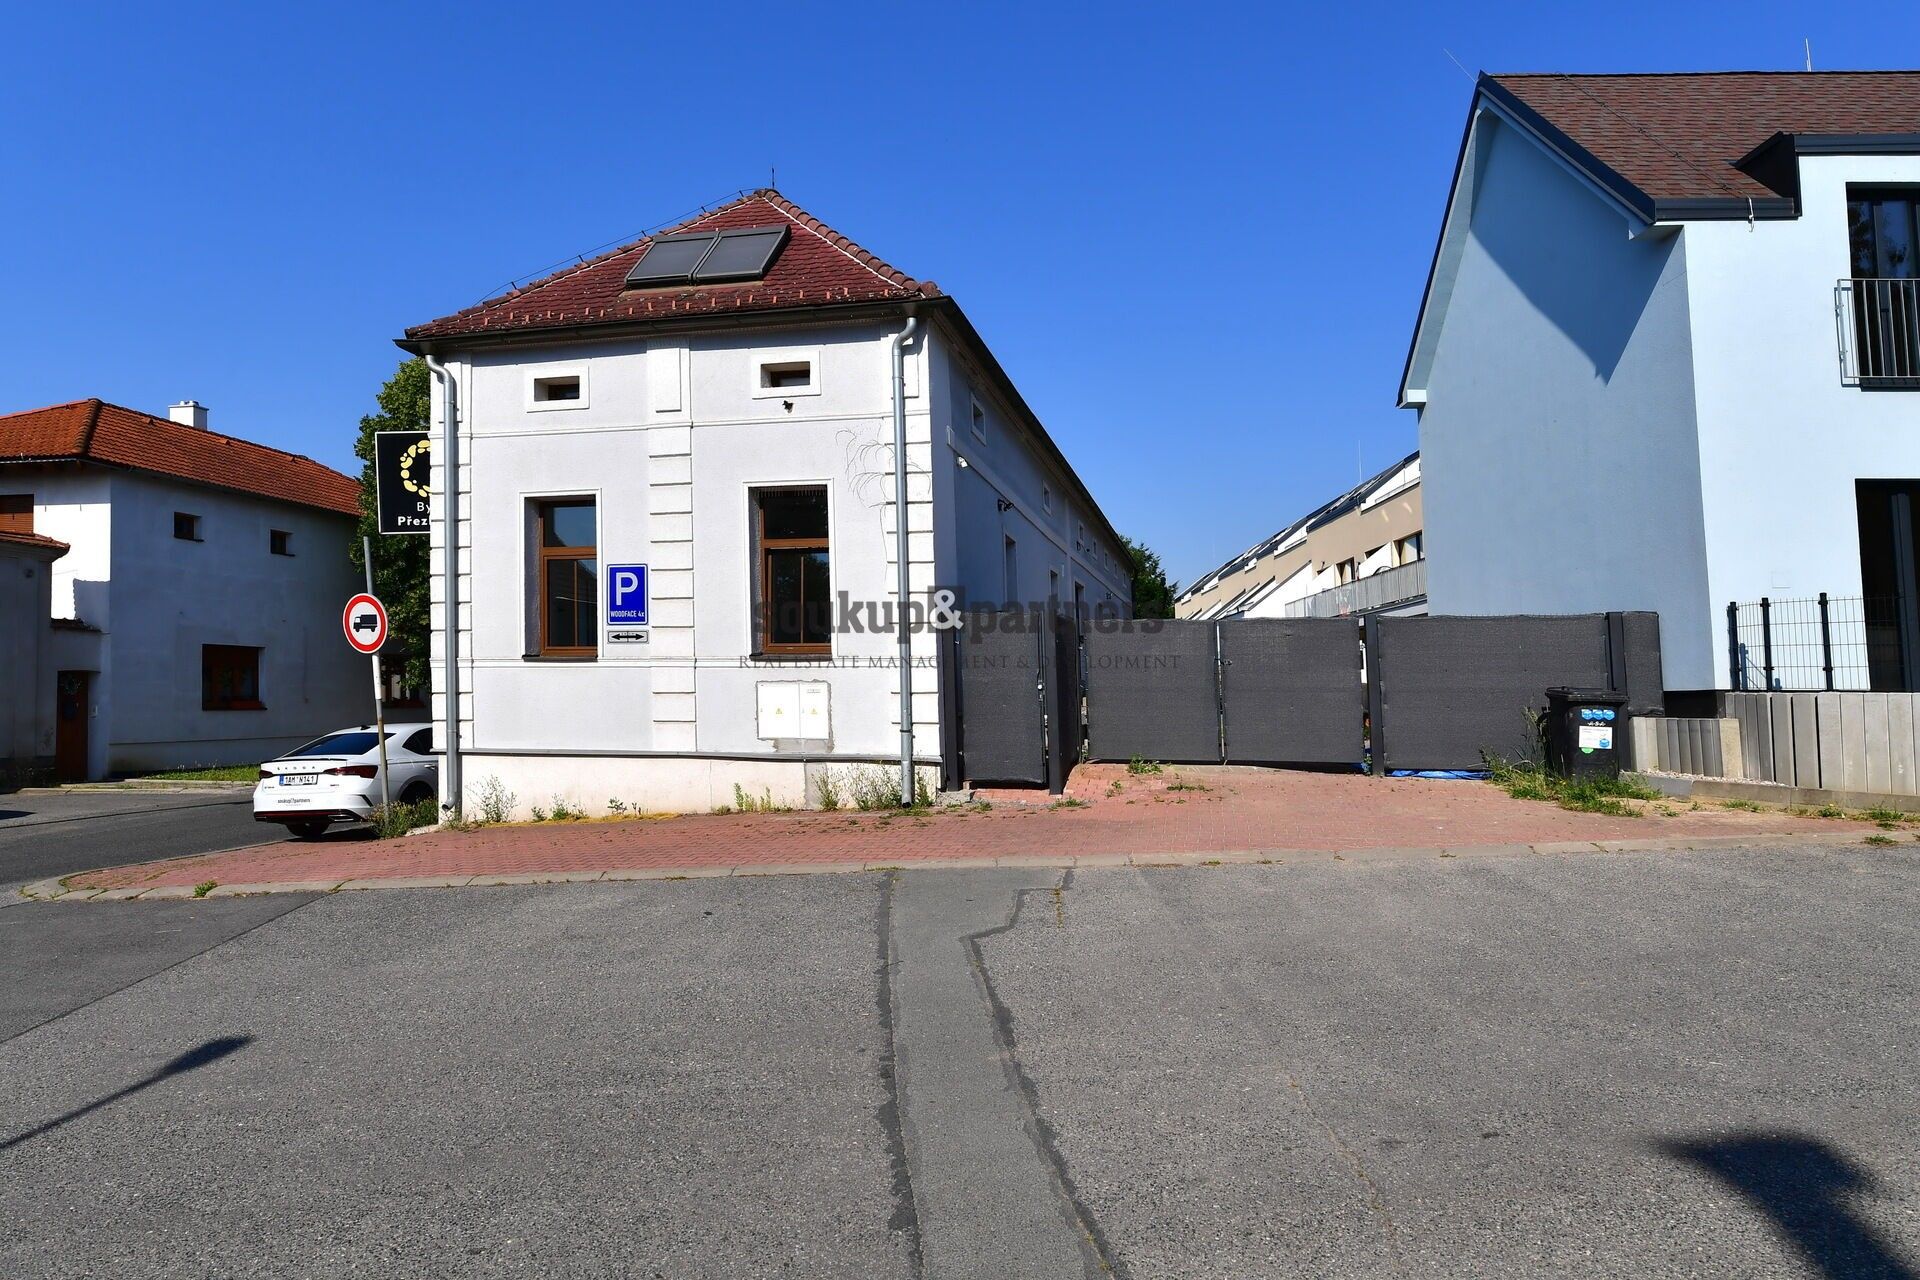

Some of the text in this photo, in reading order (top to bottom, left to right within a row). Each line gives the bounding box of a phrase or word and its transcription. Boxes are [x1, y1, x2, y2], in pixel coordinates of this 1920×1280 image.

[398, 515, 430, 526] Přez
[615, 572, 639, 606] P
[610, 610, 637, 618] WOODFACE
